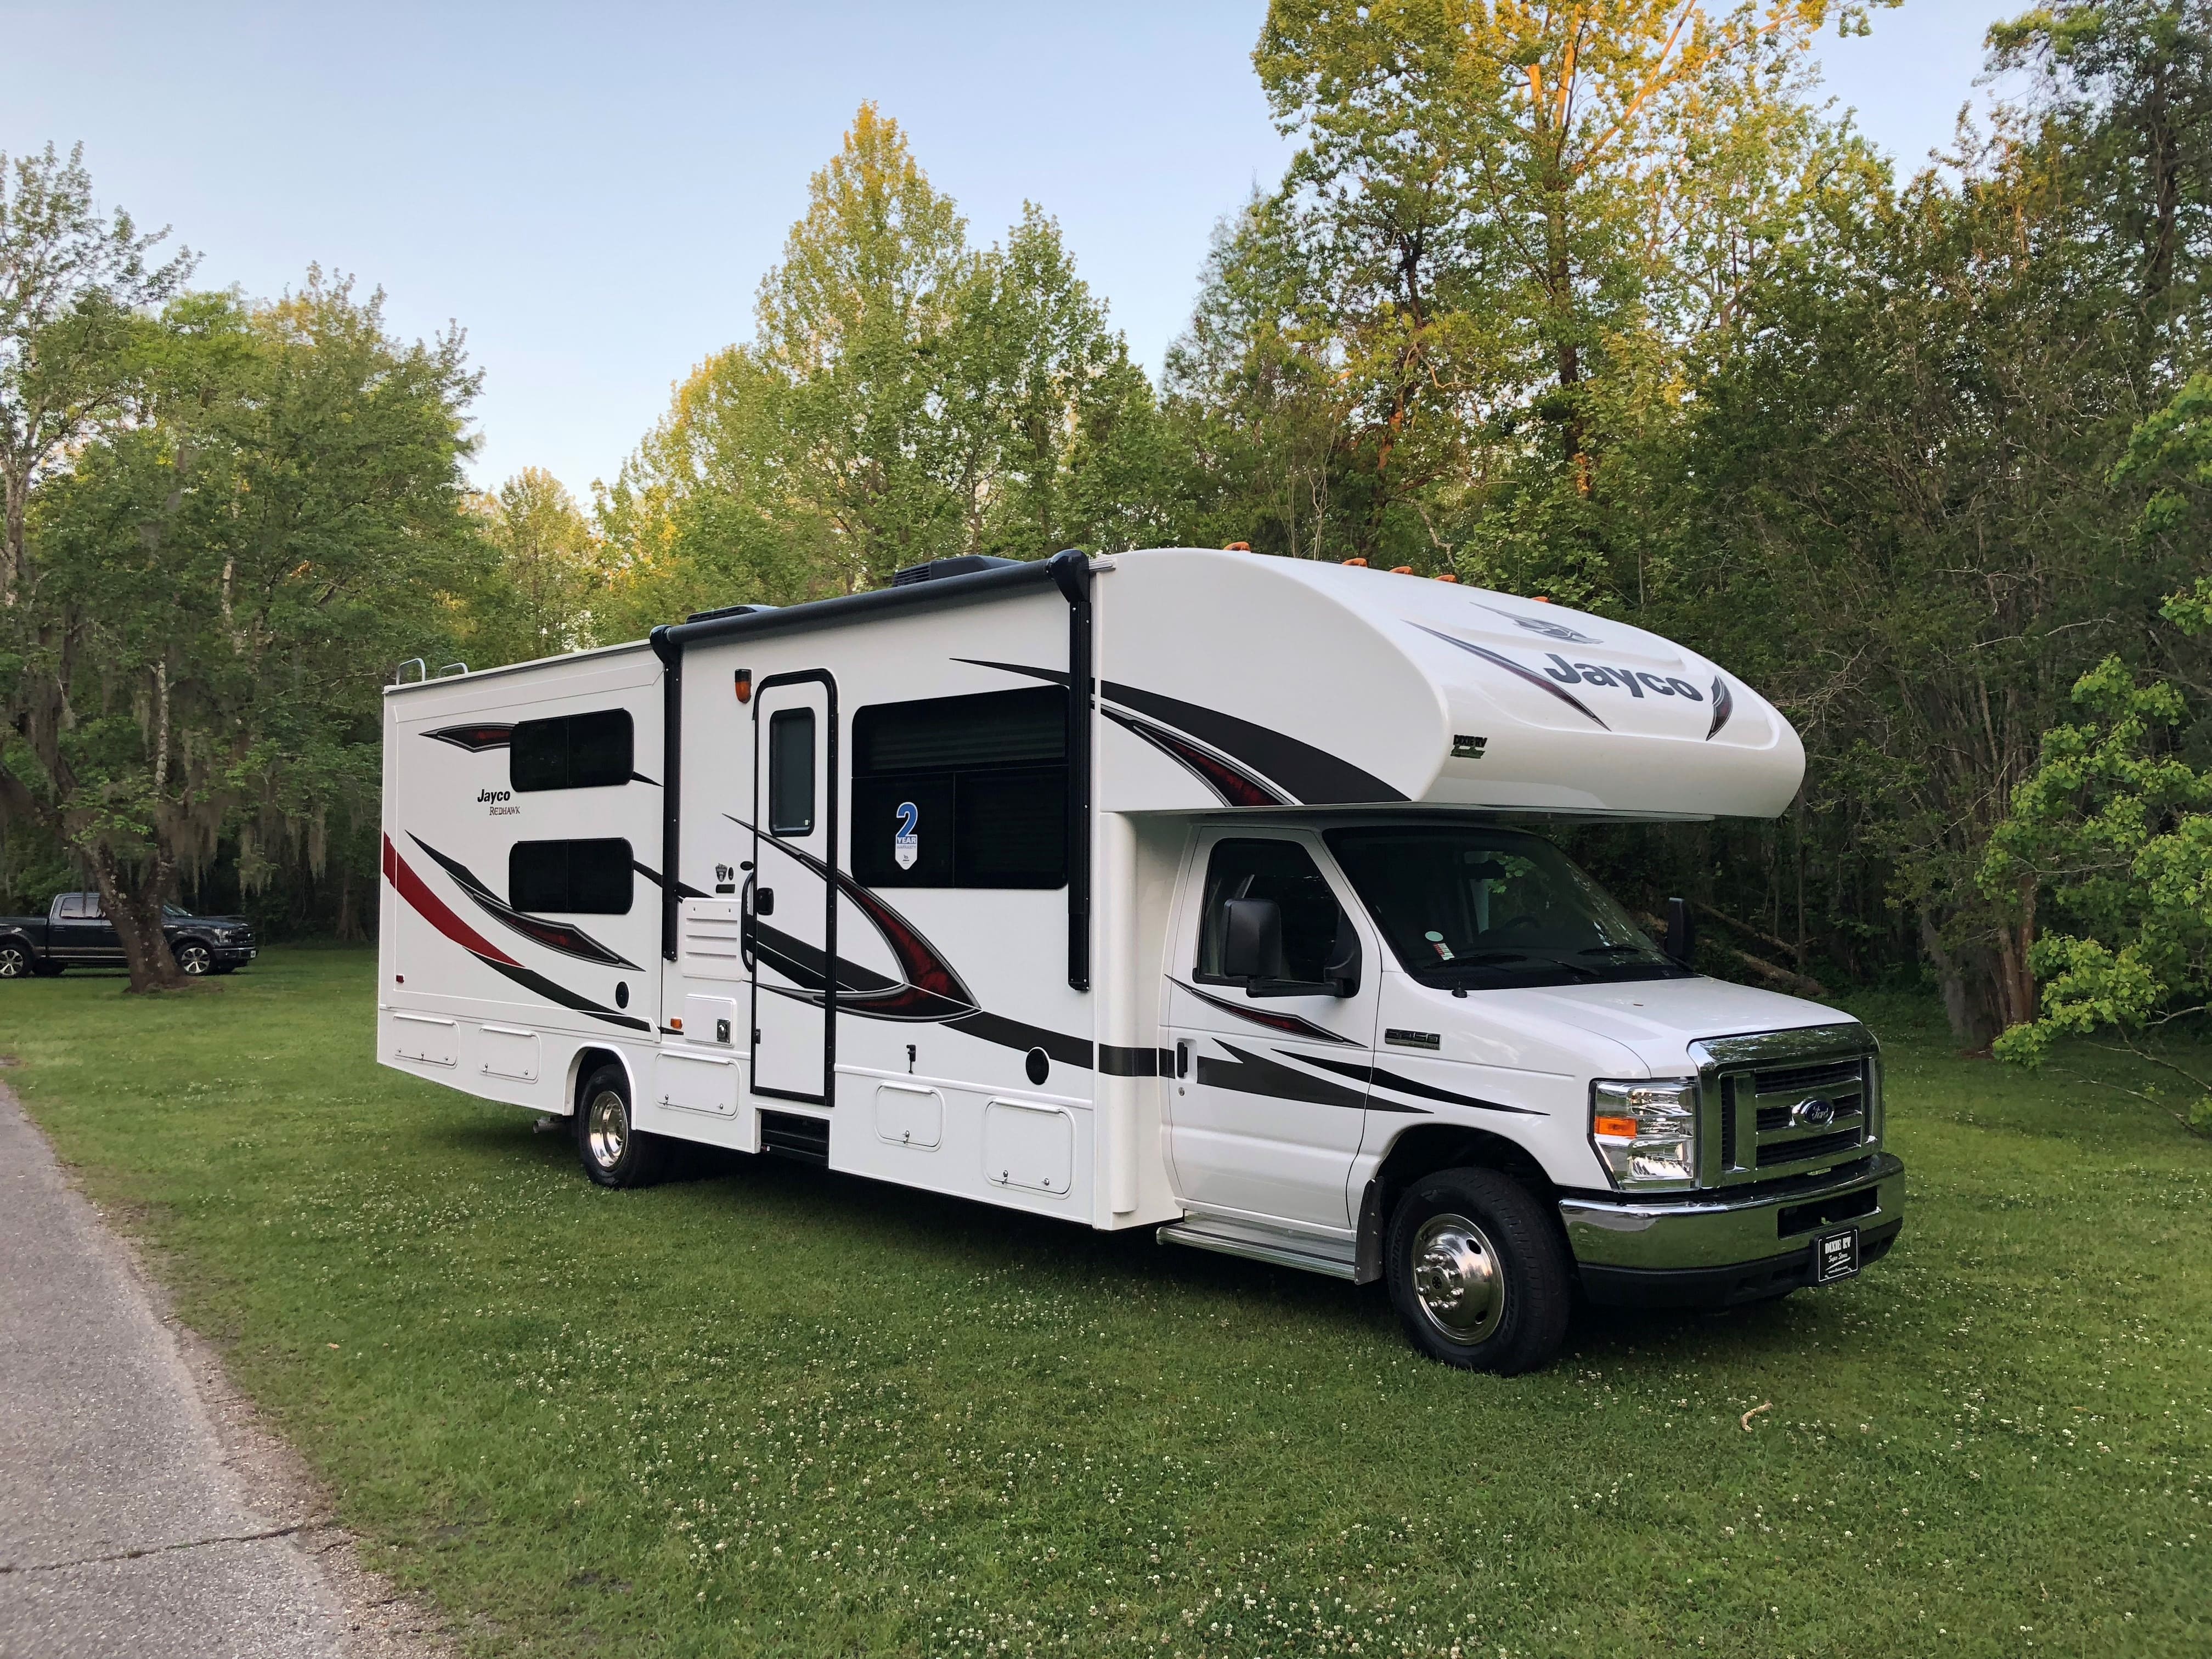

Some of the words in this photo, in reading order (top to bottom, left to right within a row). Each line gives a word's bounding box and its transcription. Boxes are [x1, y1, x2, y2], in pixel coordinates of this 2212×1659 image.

[1543, 653, 1703, 702] Jayco
[477, 789, 511, 804] Jayco
[489, 806, 521, 816] REDHAWK
[896, 802, 918, 837] 2
[1812, 1107, 1829, 1119] Ford
[1825, 1239, 1842, 1254] DIXIE
[1843, 1237, 1852, 1249] RV
